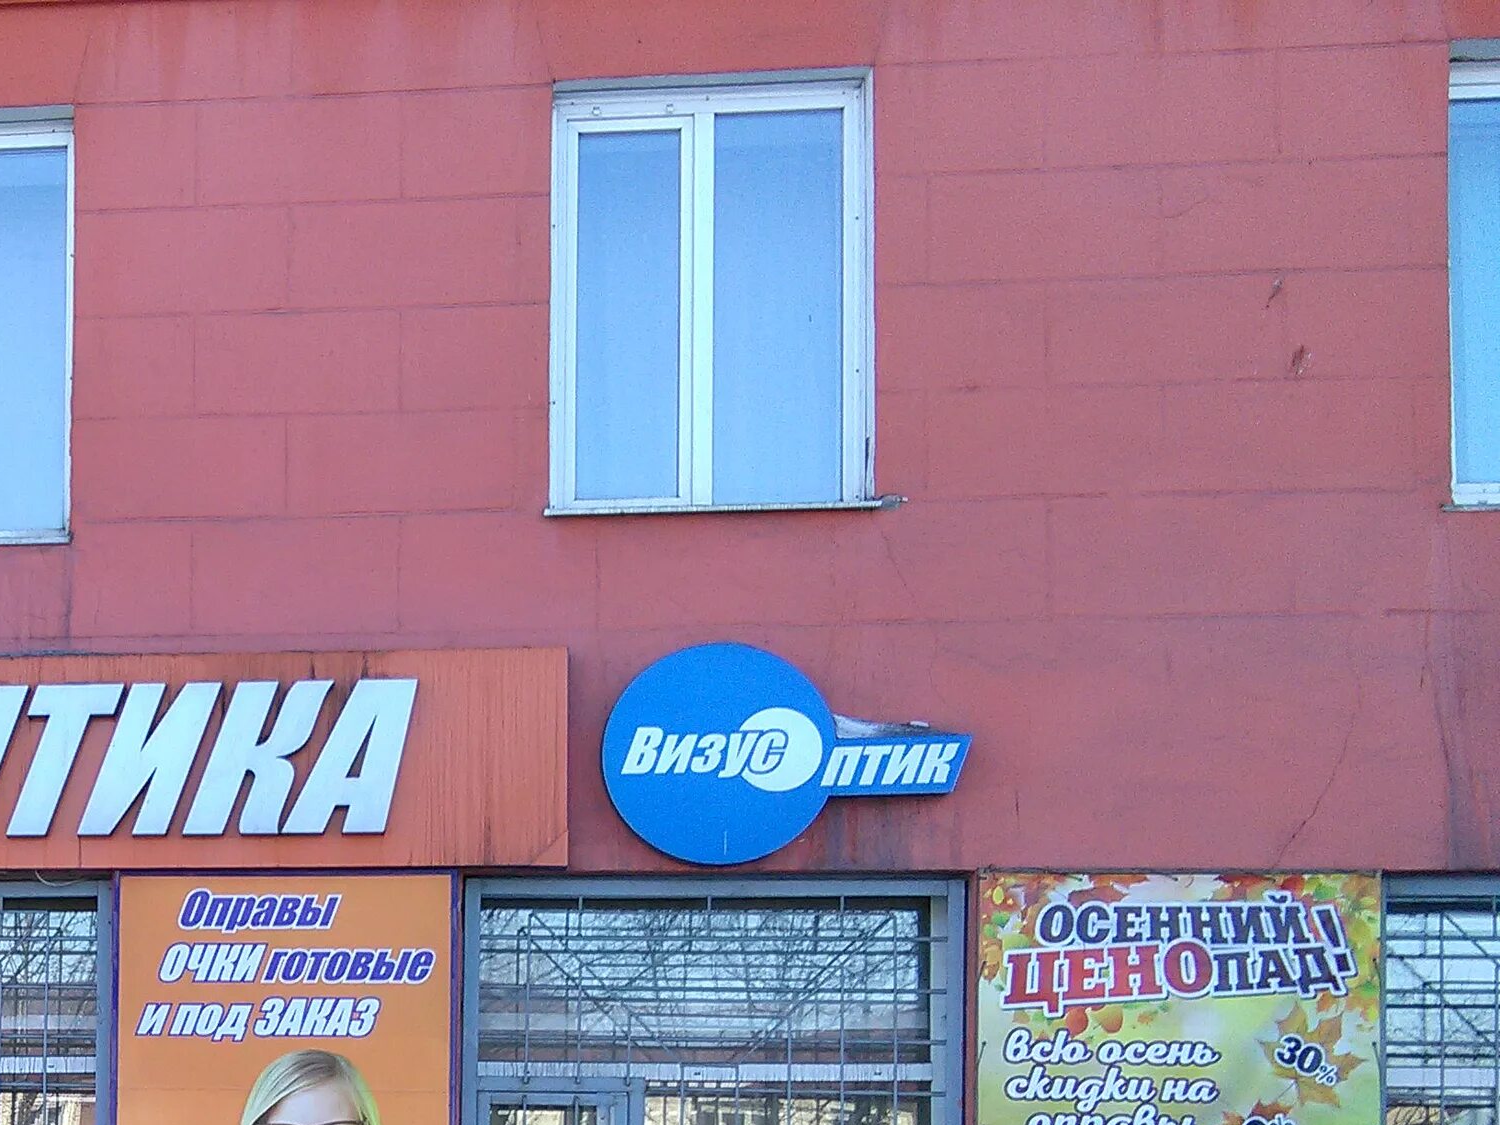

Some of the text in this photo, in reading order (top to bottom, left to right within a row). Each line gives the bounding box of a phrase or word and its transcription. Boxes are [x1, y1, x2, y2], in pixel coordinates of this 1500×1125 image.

[178, 888, 342, 933] Оправы
[1034, 891, 1312, 945] ОСЕННИЙ
[159, 942, 436, 985] ОЧКИ готовые
[134, 997, 381, 1042] и под ЗАКАЗ
[1002, 1027, 1221, 1067] всю осень
[1272, 1033, 1338, 1088] 30%
[1004, 1064, 1220, 1113] скидки на
